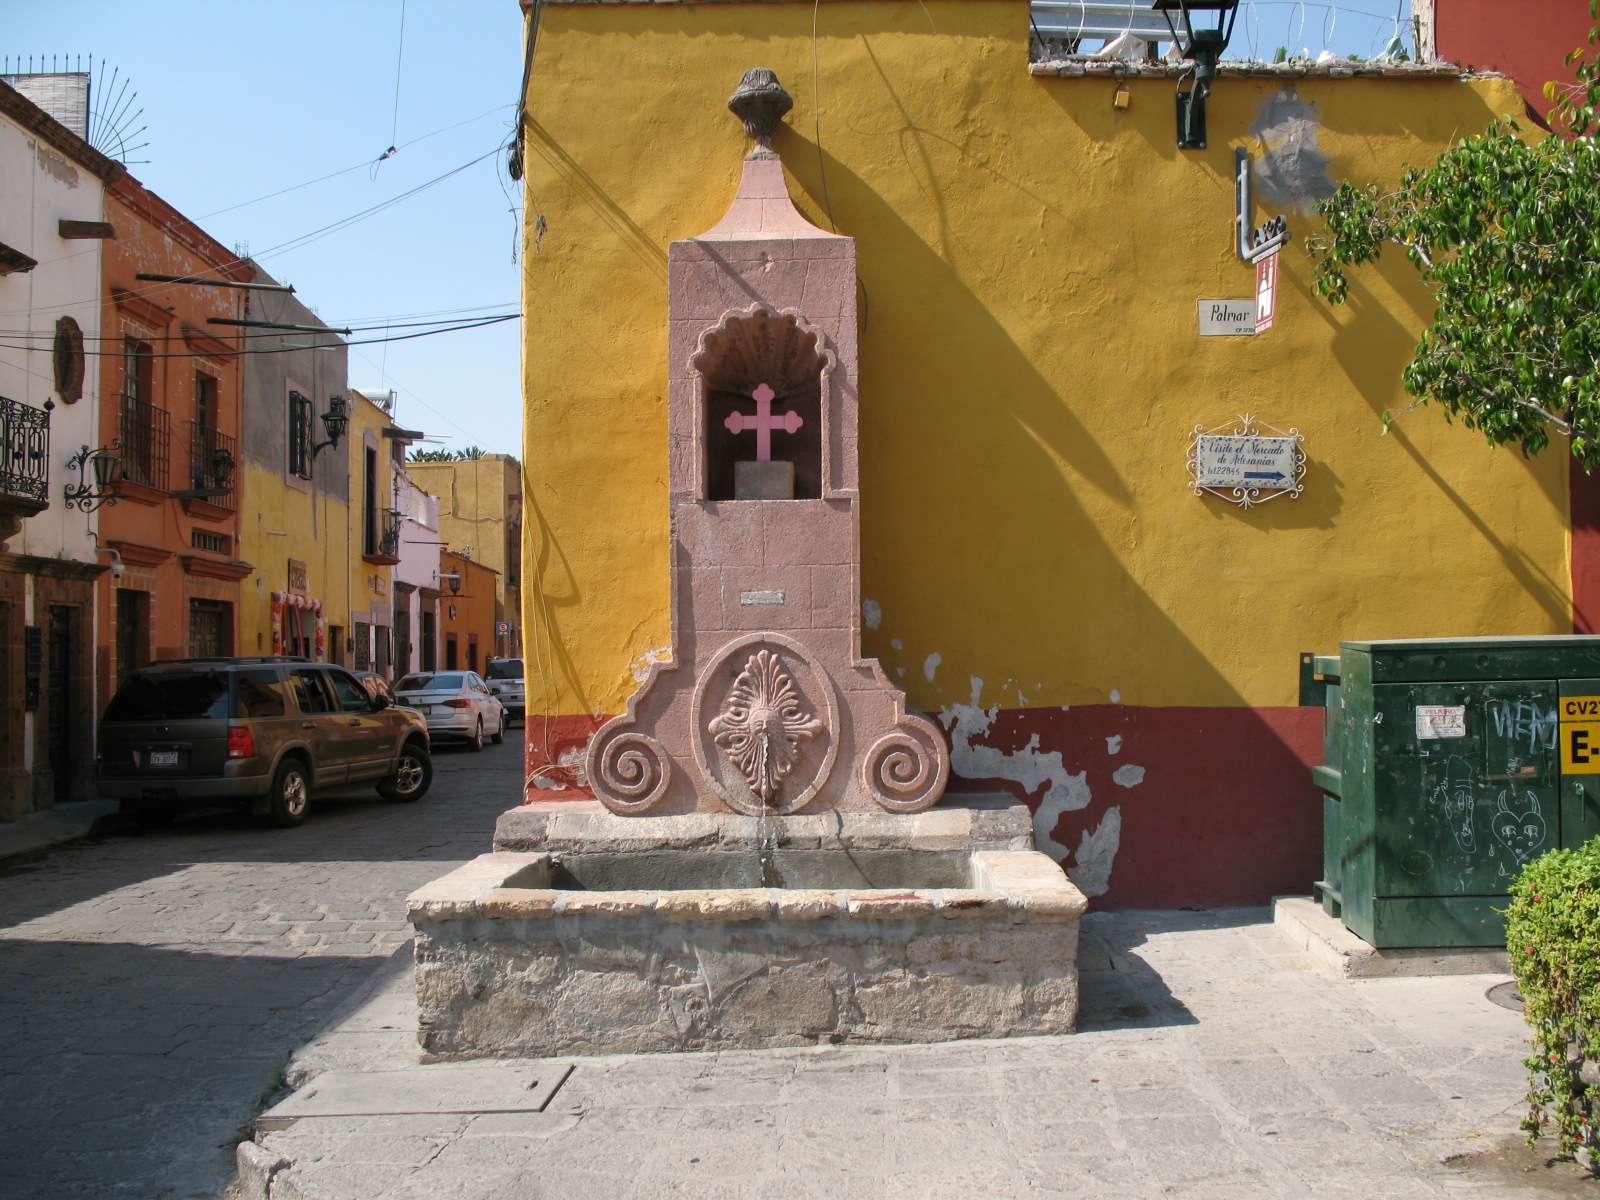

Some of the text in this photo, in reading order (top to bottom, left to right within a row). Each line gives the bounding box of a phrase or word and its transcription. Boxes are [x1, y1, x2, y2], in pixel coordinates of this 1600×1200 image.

[1210, 304, 1250, 322] Palmar
[1209, 441, 1285, 456] Visite el Mercado
[1217, 454, 1227, 464] de
